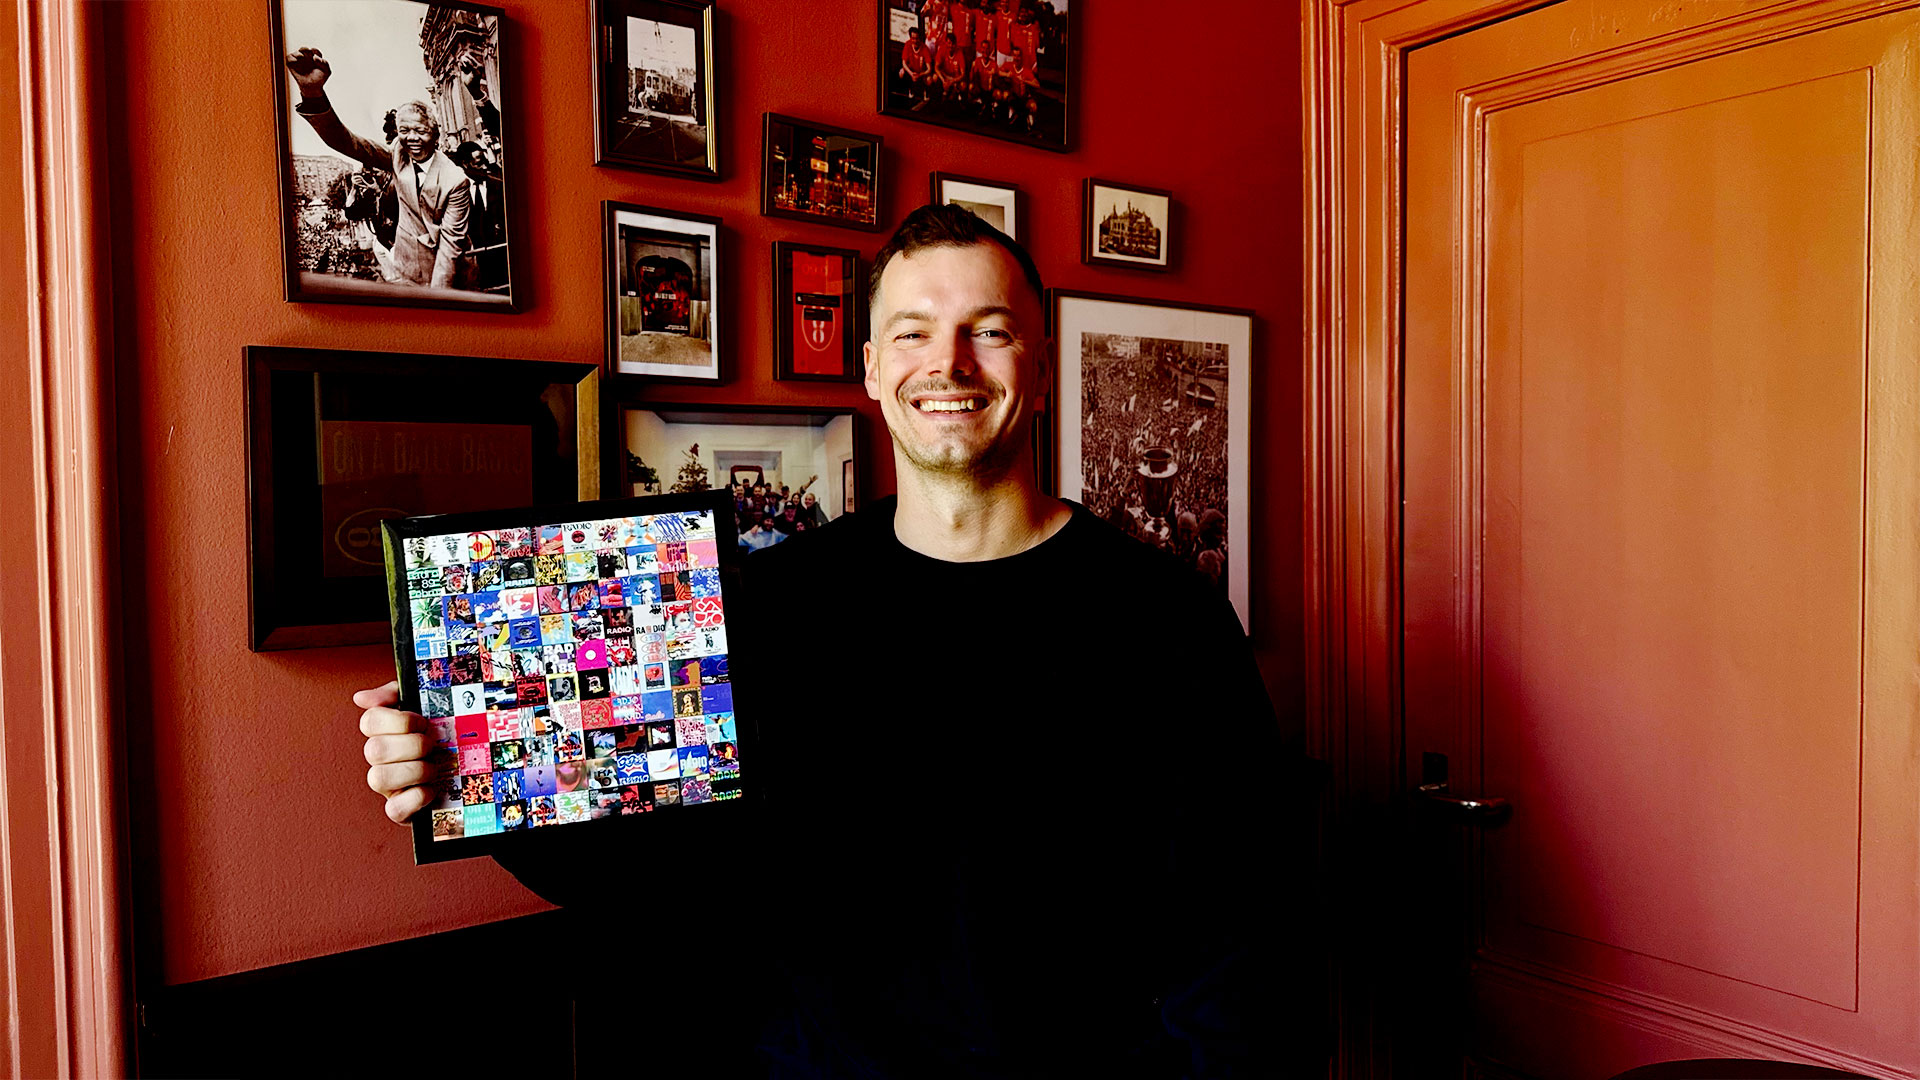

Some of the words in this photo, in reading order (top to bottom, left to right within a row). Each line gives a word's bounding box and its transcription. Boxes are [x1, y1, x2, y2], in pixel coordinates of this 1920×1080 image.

[562, 522, 592, 532] RADIO
[503, 578, 534, 588] RADIO
[606, 625, 633, 635] RADIO
[543, 643, 574, 655] RAD
